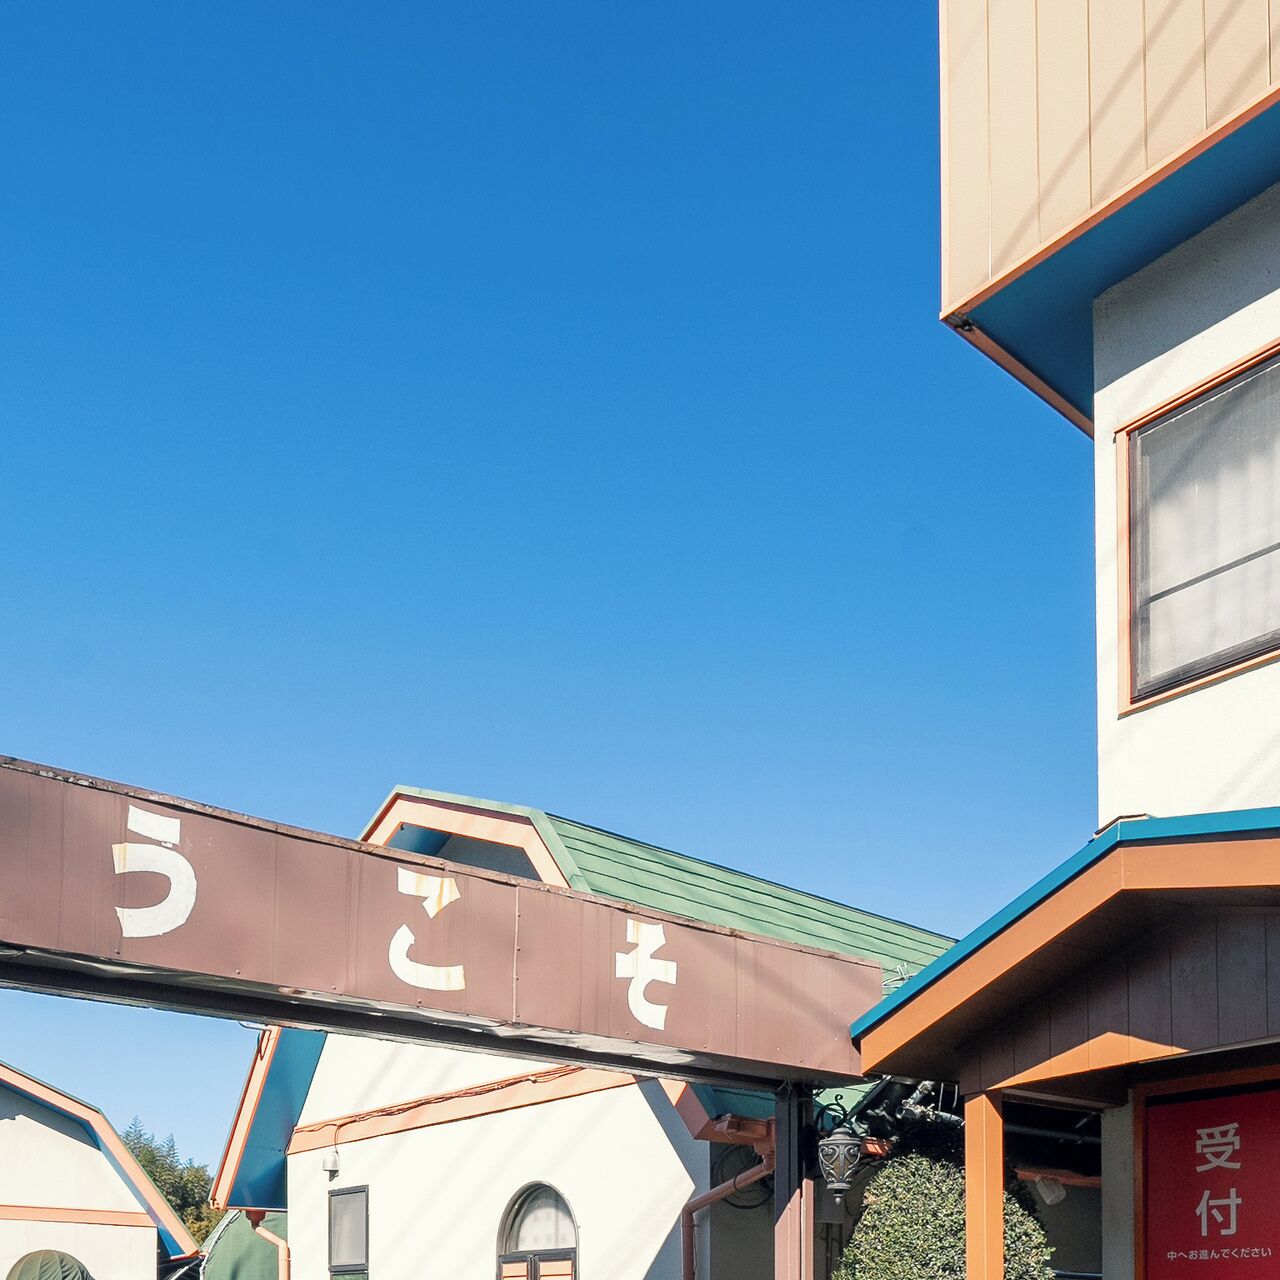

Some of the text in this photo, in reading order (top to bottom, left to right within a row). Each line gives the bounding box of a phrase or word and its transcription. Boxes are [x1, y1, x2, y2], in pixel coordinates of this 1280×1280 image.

[1195, 1122, 1243, 1237] 受付
[1167, 1247, 1272, 1261] 中へお進んでください
